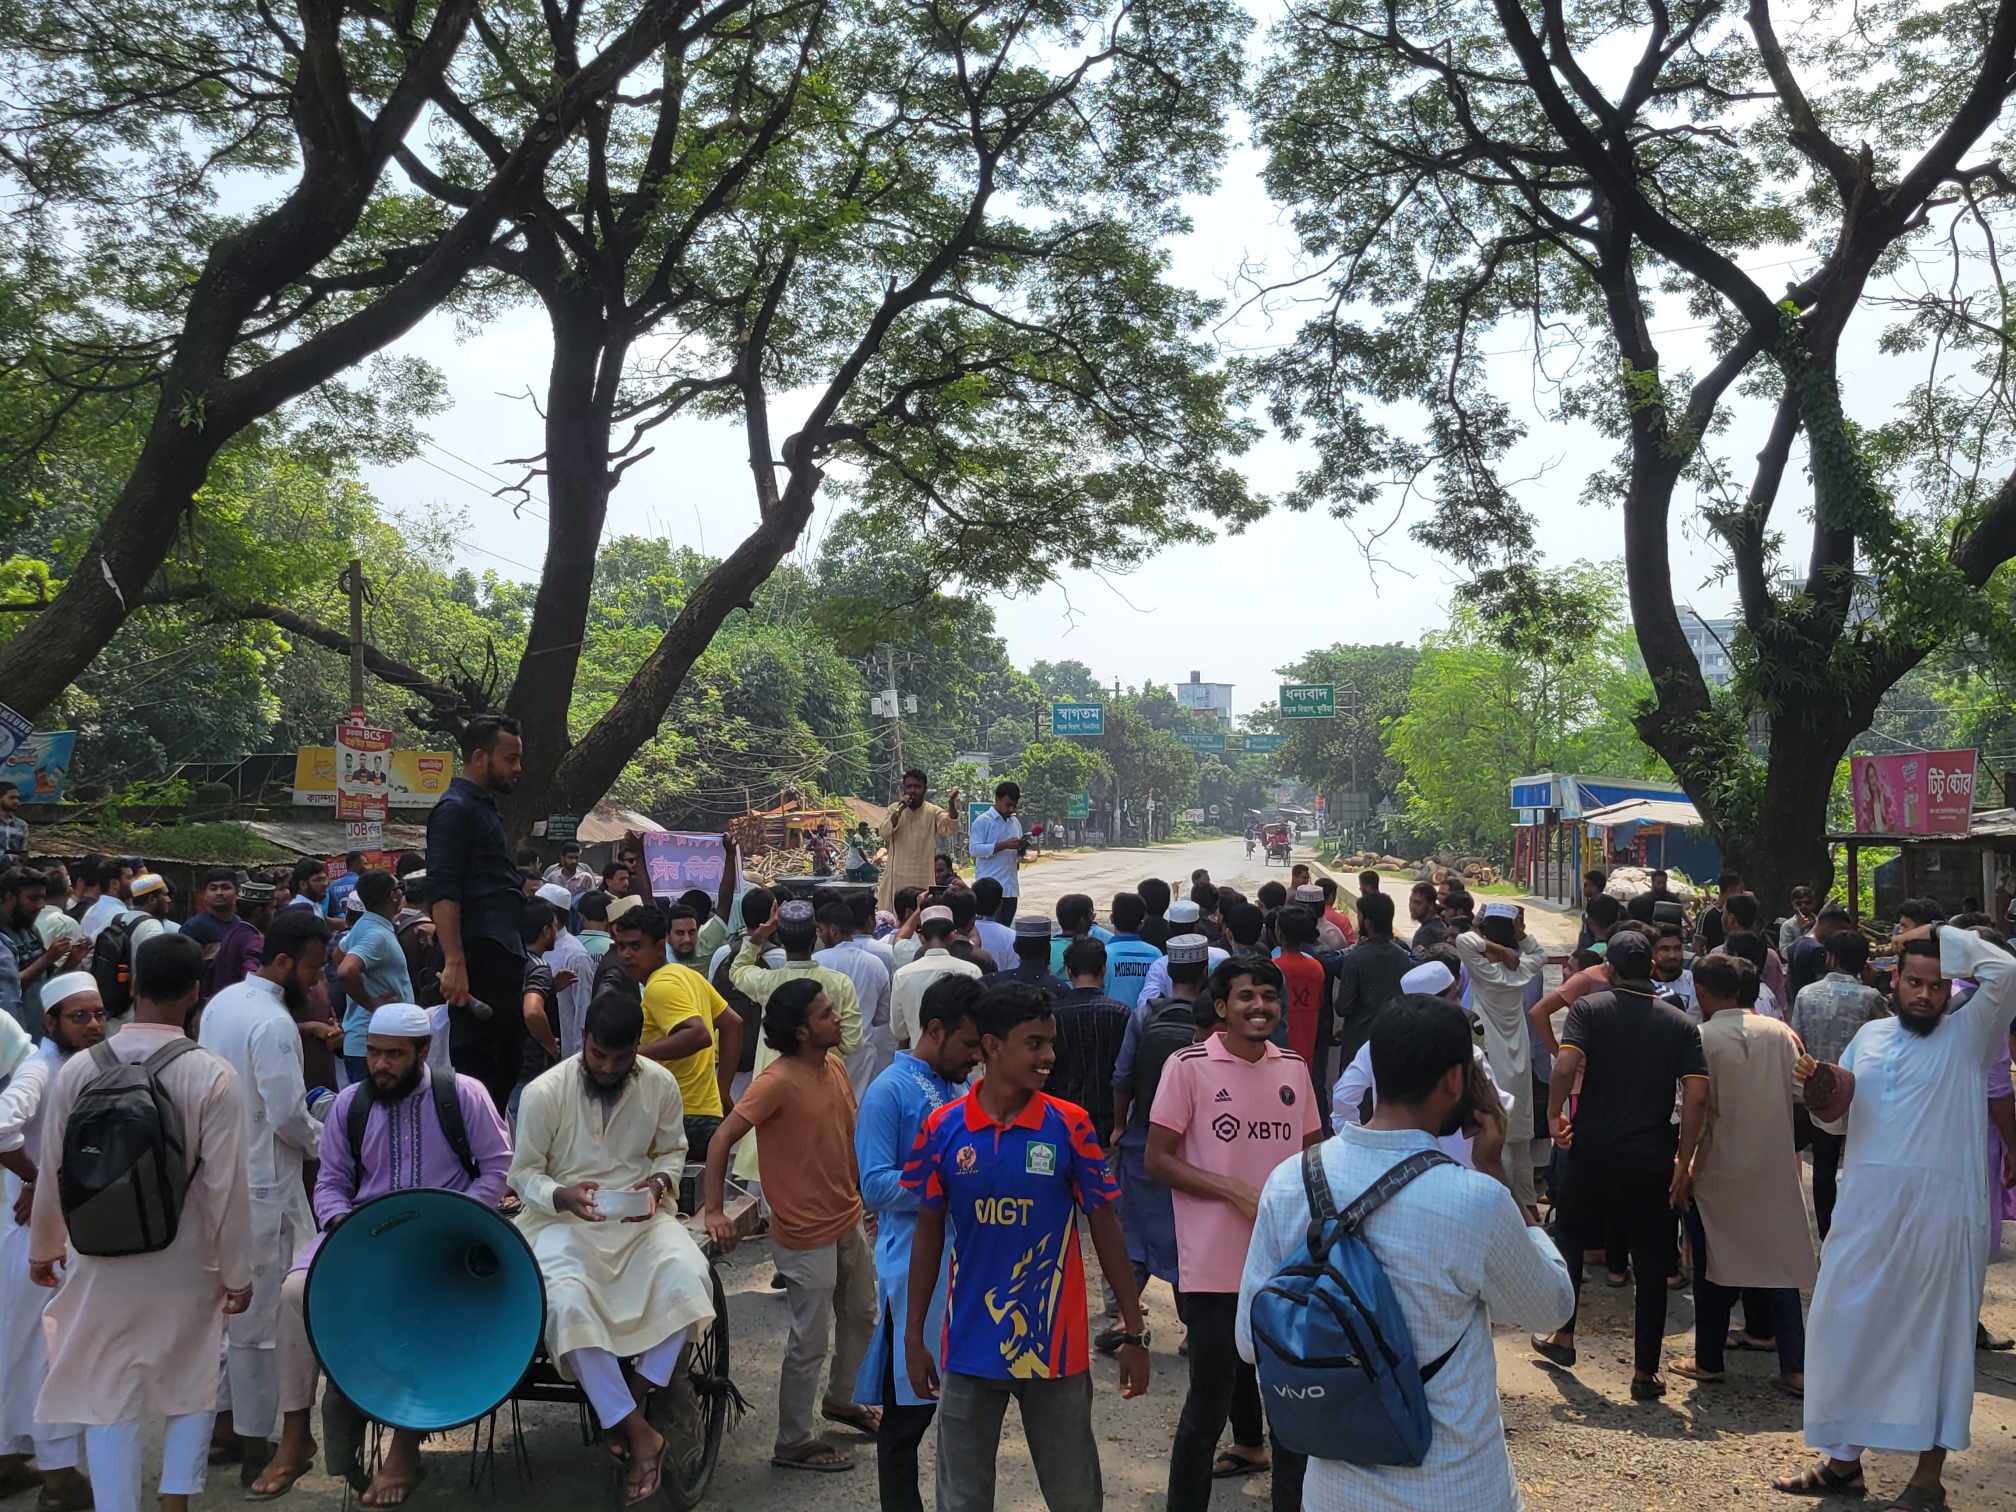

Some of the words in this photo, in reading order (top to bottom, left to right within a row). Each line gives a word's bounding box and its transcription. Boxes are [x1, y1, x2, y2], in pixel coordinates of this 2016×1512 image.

[1286, 688, 1329, 701] ধন্যবাদ
[1056, 708, 1101, 720] স্বাগতম
[1928, 768, 1945, 802] টিটু
[347, 823, 367, 837] JOB
[1247, 1121, 1292, 1141] XBTO
